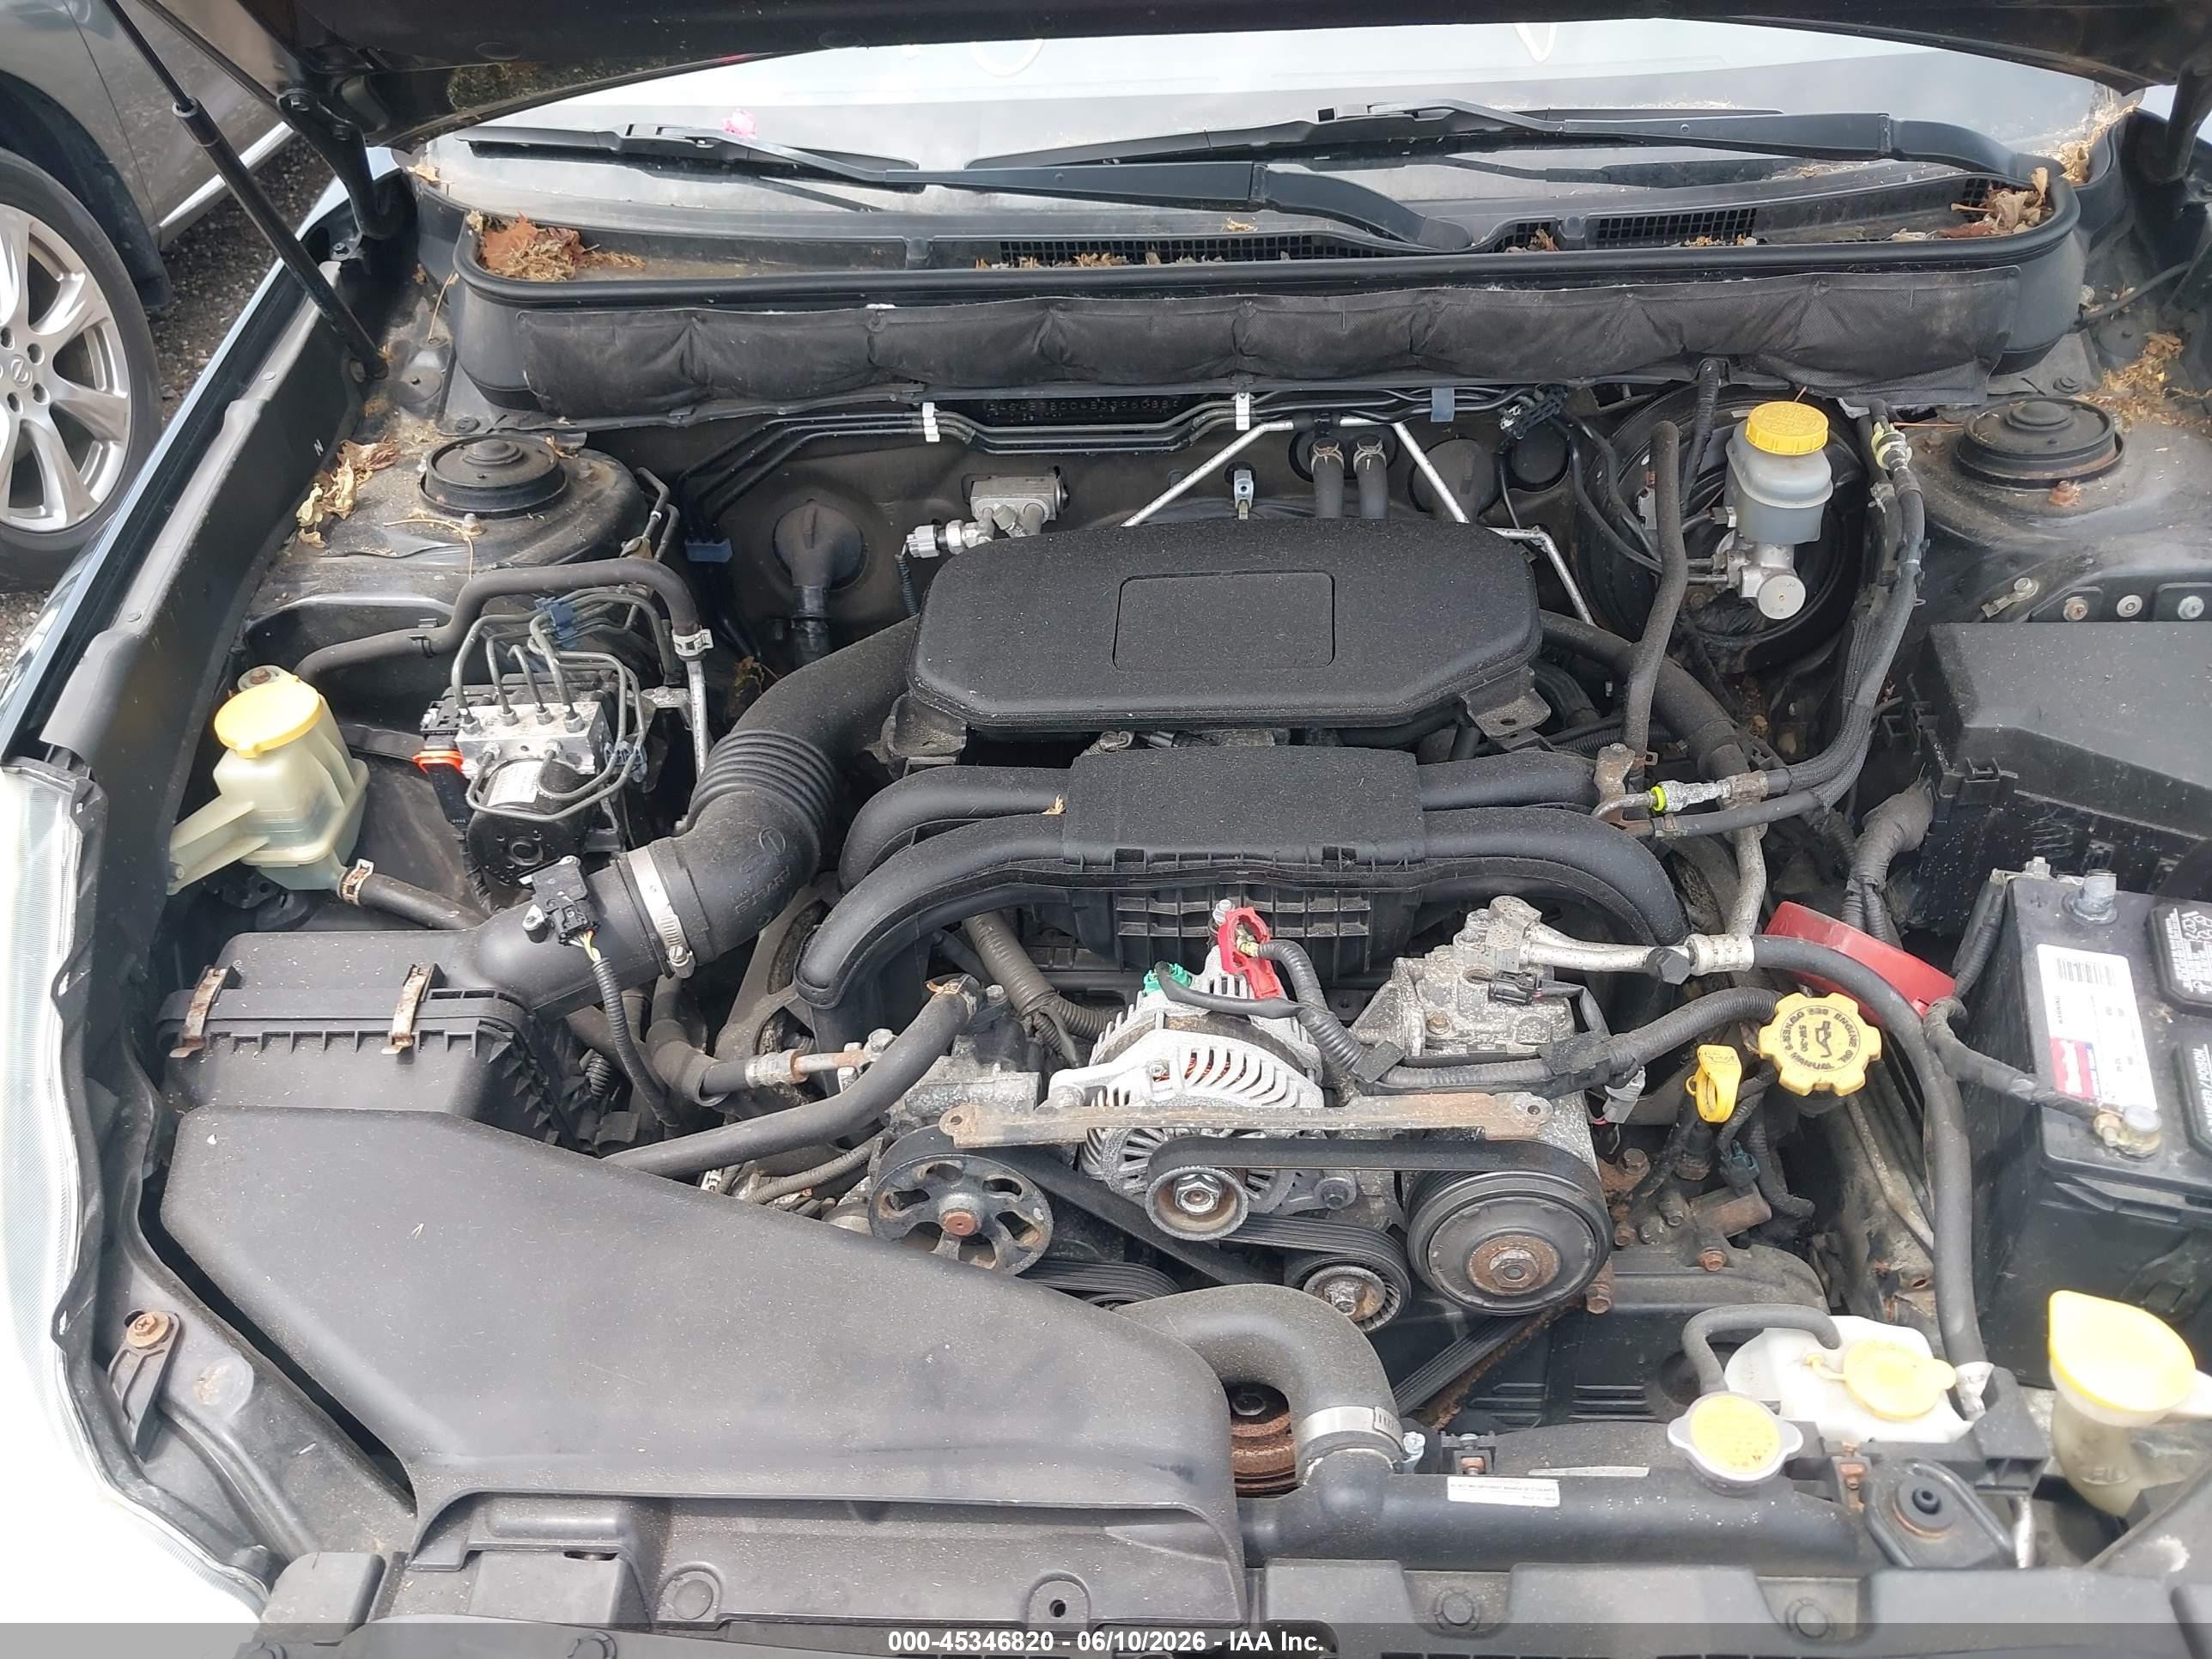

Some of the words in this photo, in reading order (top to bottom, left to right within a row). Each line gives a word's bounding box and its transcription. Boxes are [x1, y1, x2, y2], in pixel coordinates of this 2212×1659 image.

[1782, 1011, 1805, 1050] OWNER'S
[1798, 1024, 1808, 1052] 5W-30
[1834, 1012, 1857, 1048] ENGINE
[1790, 1052, 1834, 1070] MANUAL
[1837, 1049, 1854, 1063] OIL
